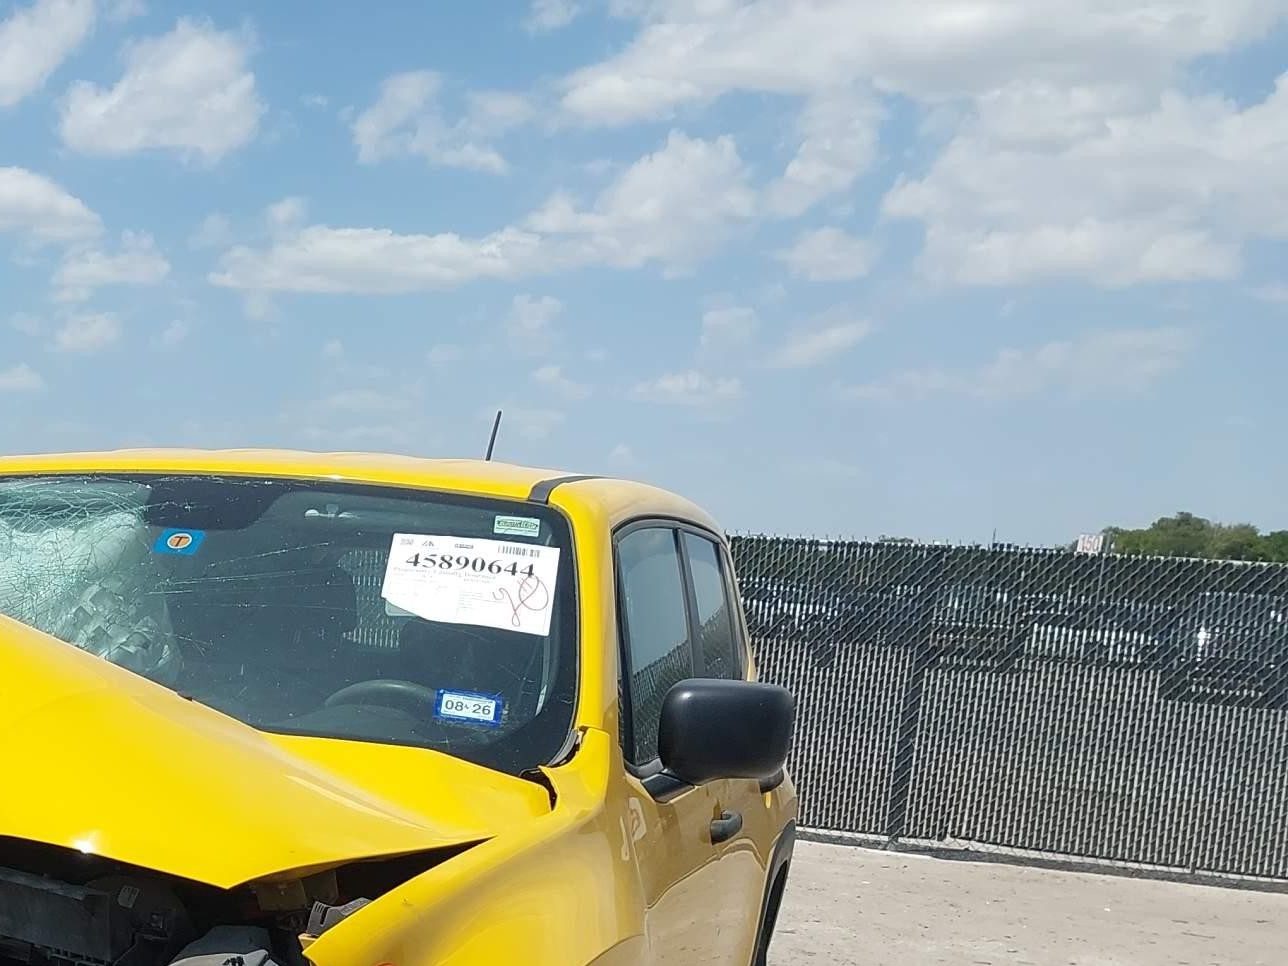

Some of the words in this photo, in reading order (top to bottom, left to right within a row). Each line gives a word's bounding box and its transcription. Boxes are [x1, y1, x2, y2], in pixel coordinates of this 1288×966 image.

[406, 552, 534, 577] 45890644
[445, 699, 464, 712] 08
[472, 703, 492, 716] 26
